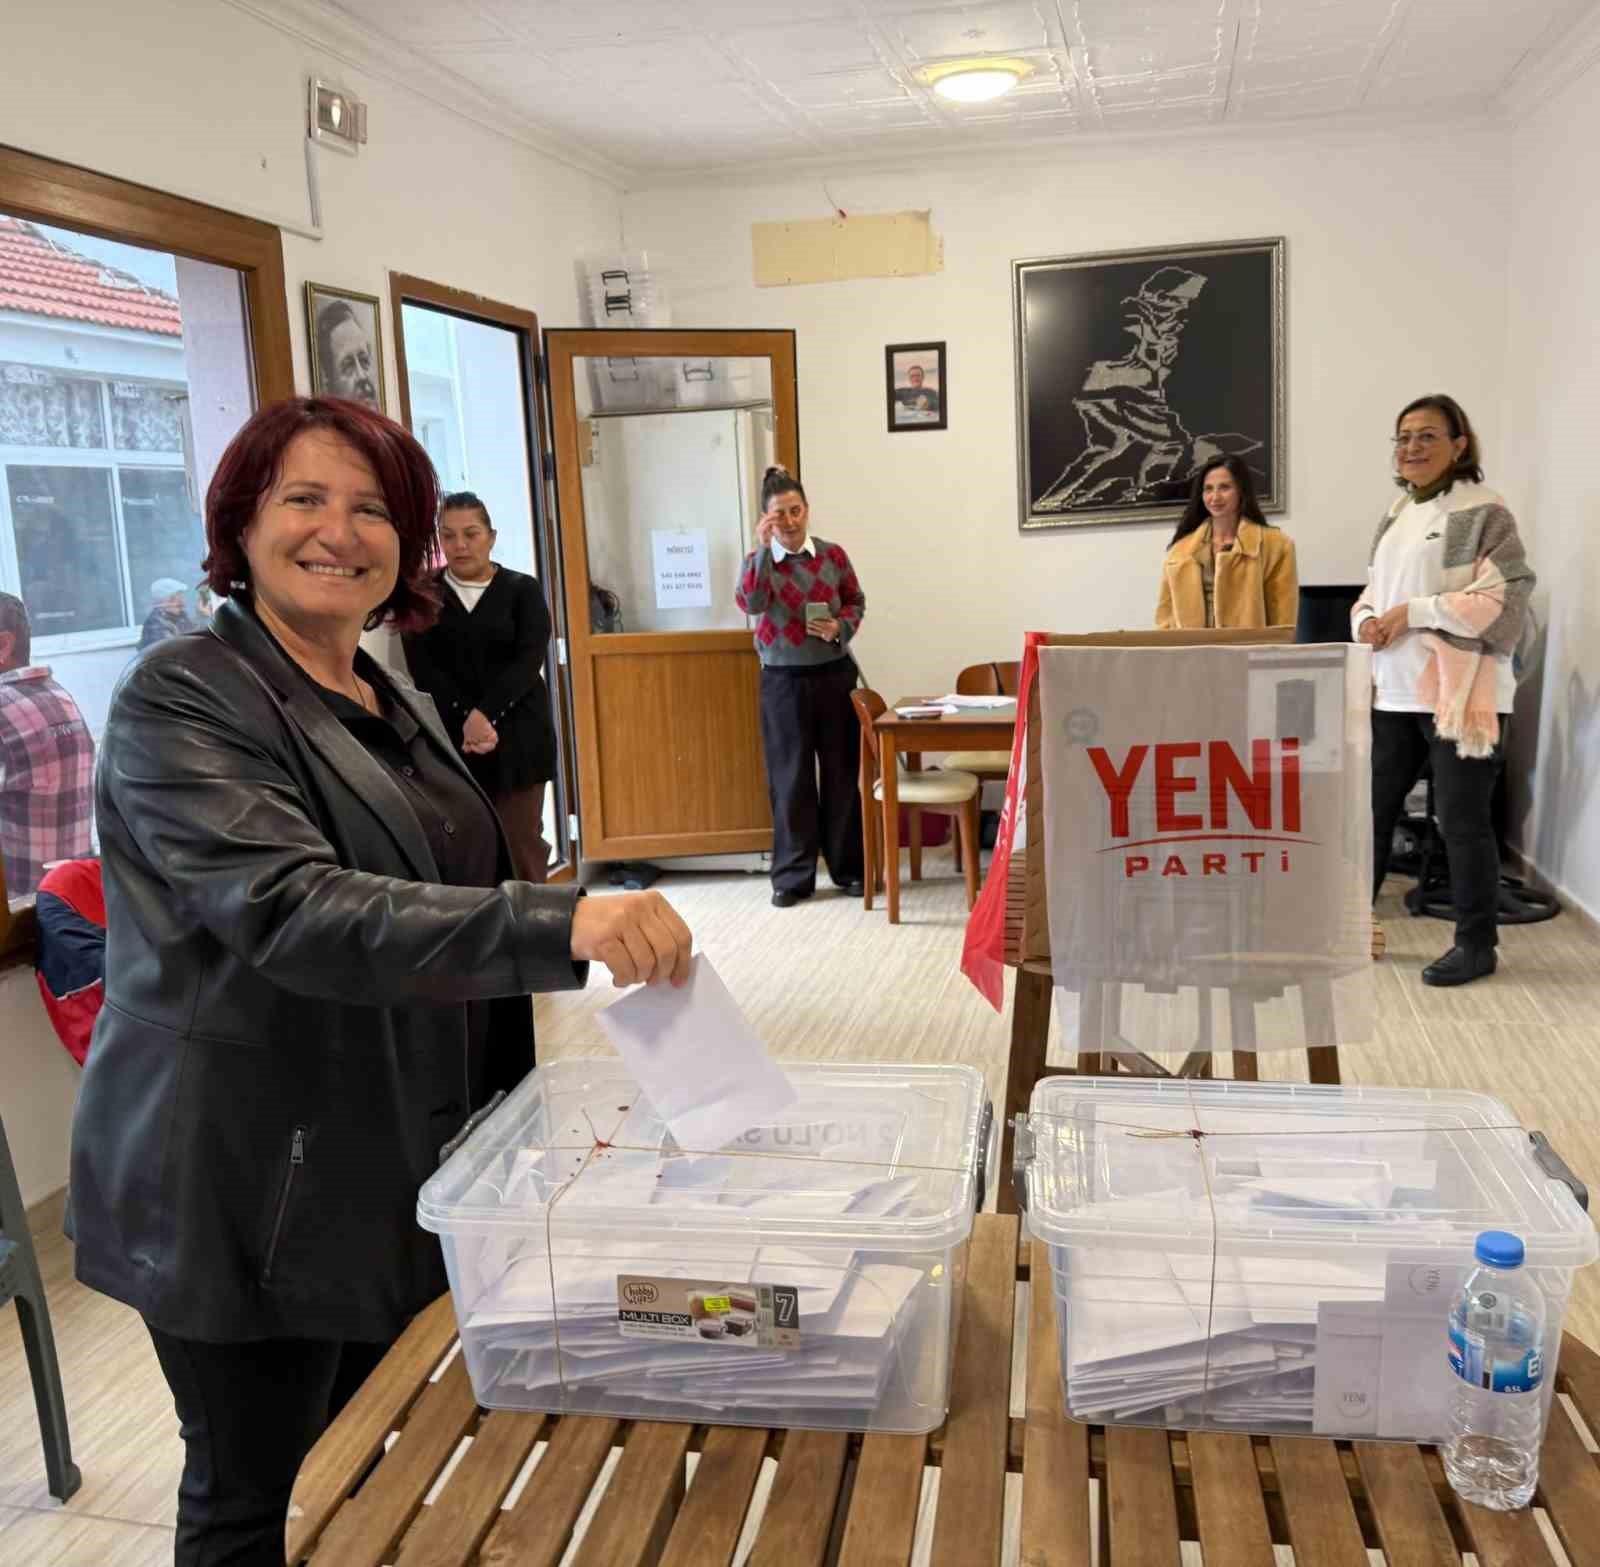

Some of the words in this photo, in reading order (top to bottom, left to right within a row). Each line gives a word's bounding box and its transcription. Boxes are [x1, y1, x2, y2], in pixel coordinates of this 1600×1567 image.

[775, 1293, 795, 1321] 7
[622, 1311, 660, 1322] MULTI
[661, 1313, 689, 1325] BOX
